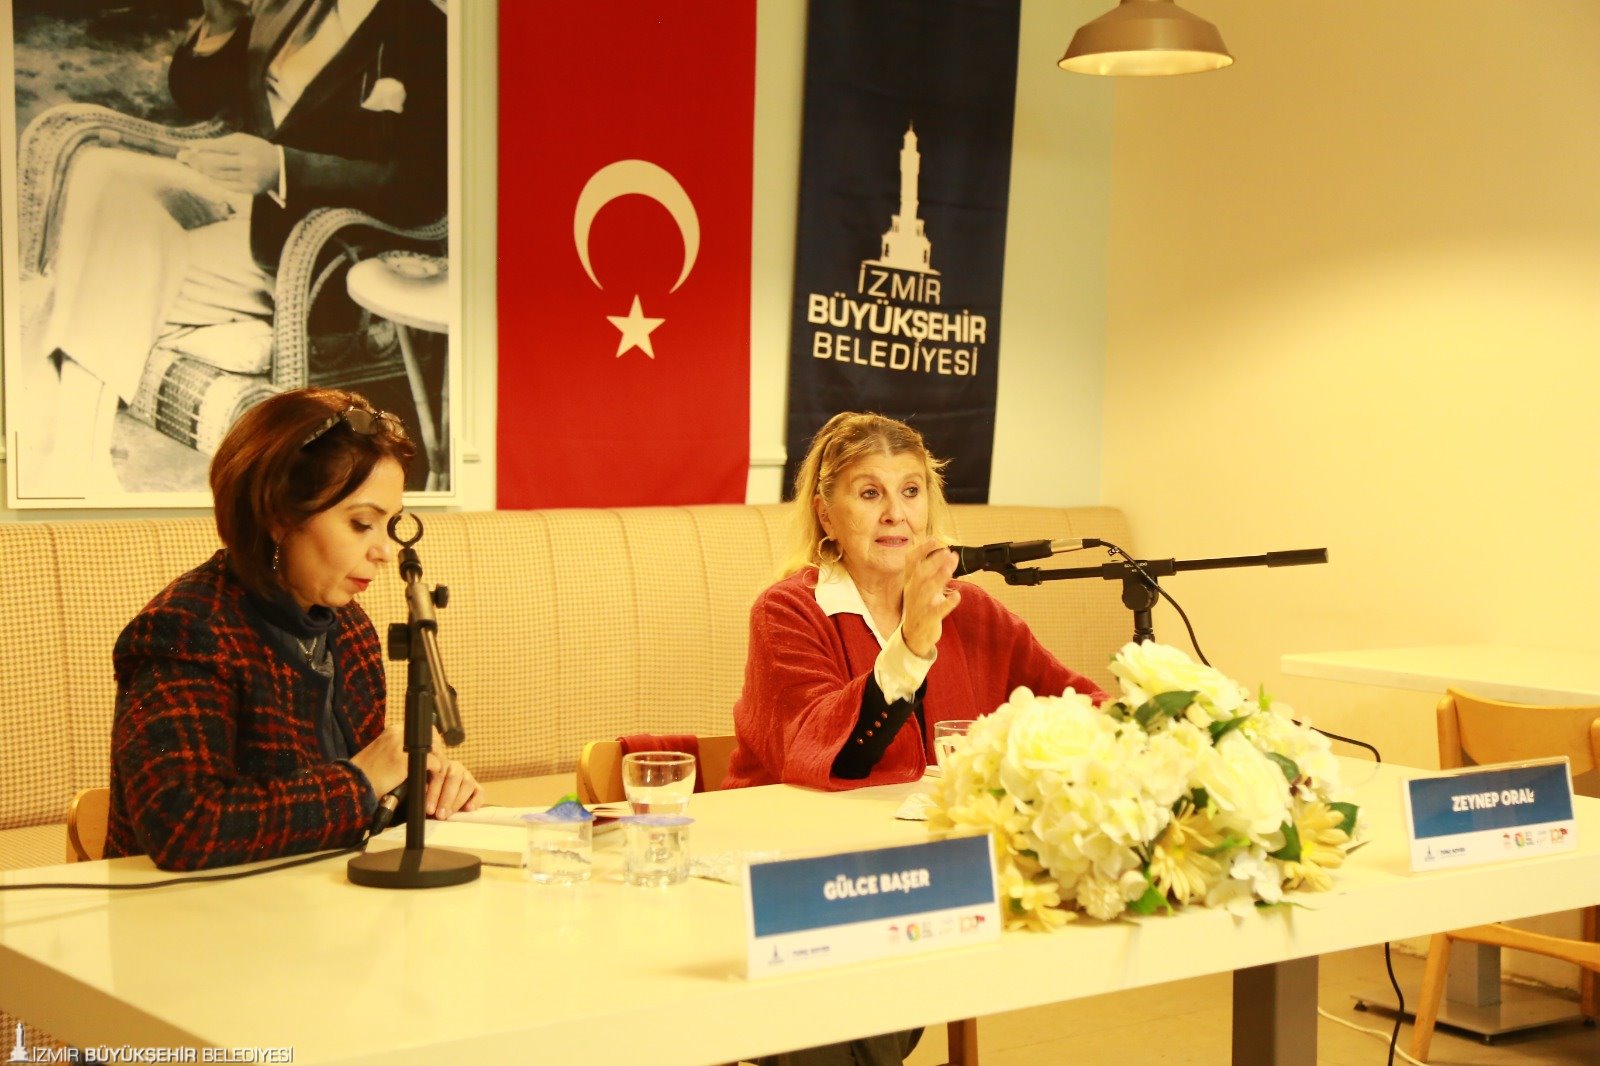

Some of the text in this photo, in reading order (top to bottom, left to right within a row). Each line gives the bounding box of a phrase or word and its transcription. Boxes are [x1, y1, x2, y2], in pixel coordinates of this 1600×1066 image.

[858, 264, 941, 305] İZMİR
[808, 292, 987, 344] BÜYÜKŞEHİR
[813, 331, 978, 376] BELEDİYESİ
[1451, 791, 1500, 812] ZEYNEP
[824, 868, 931, 901] GÜLCE BAŞER
